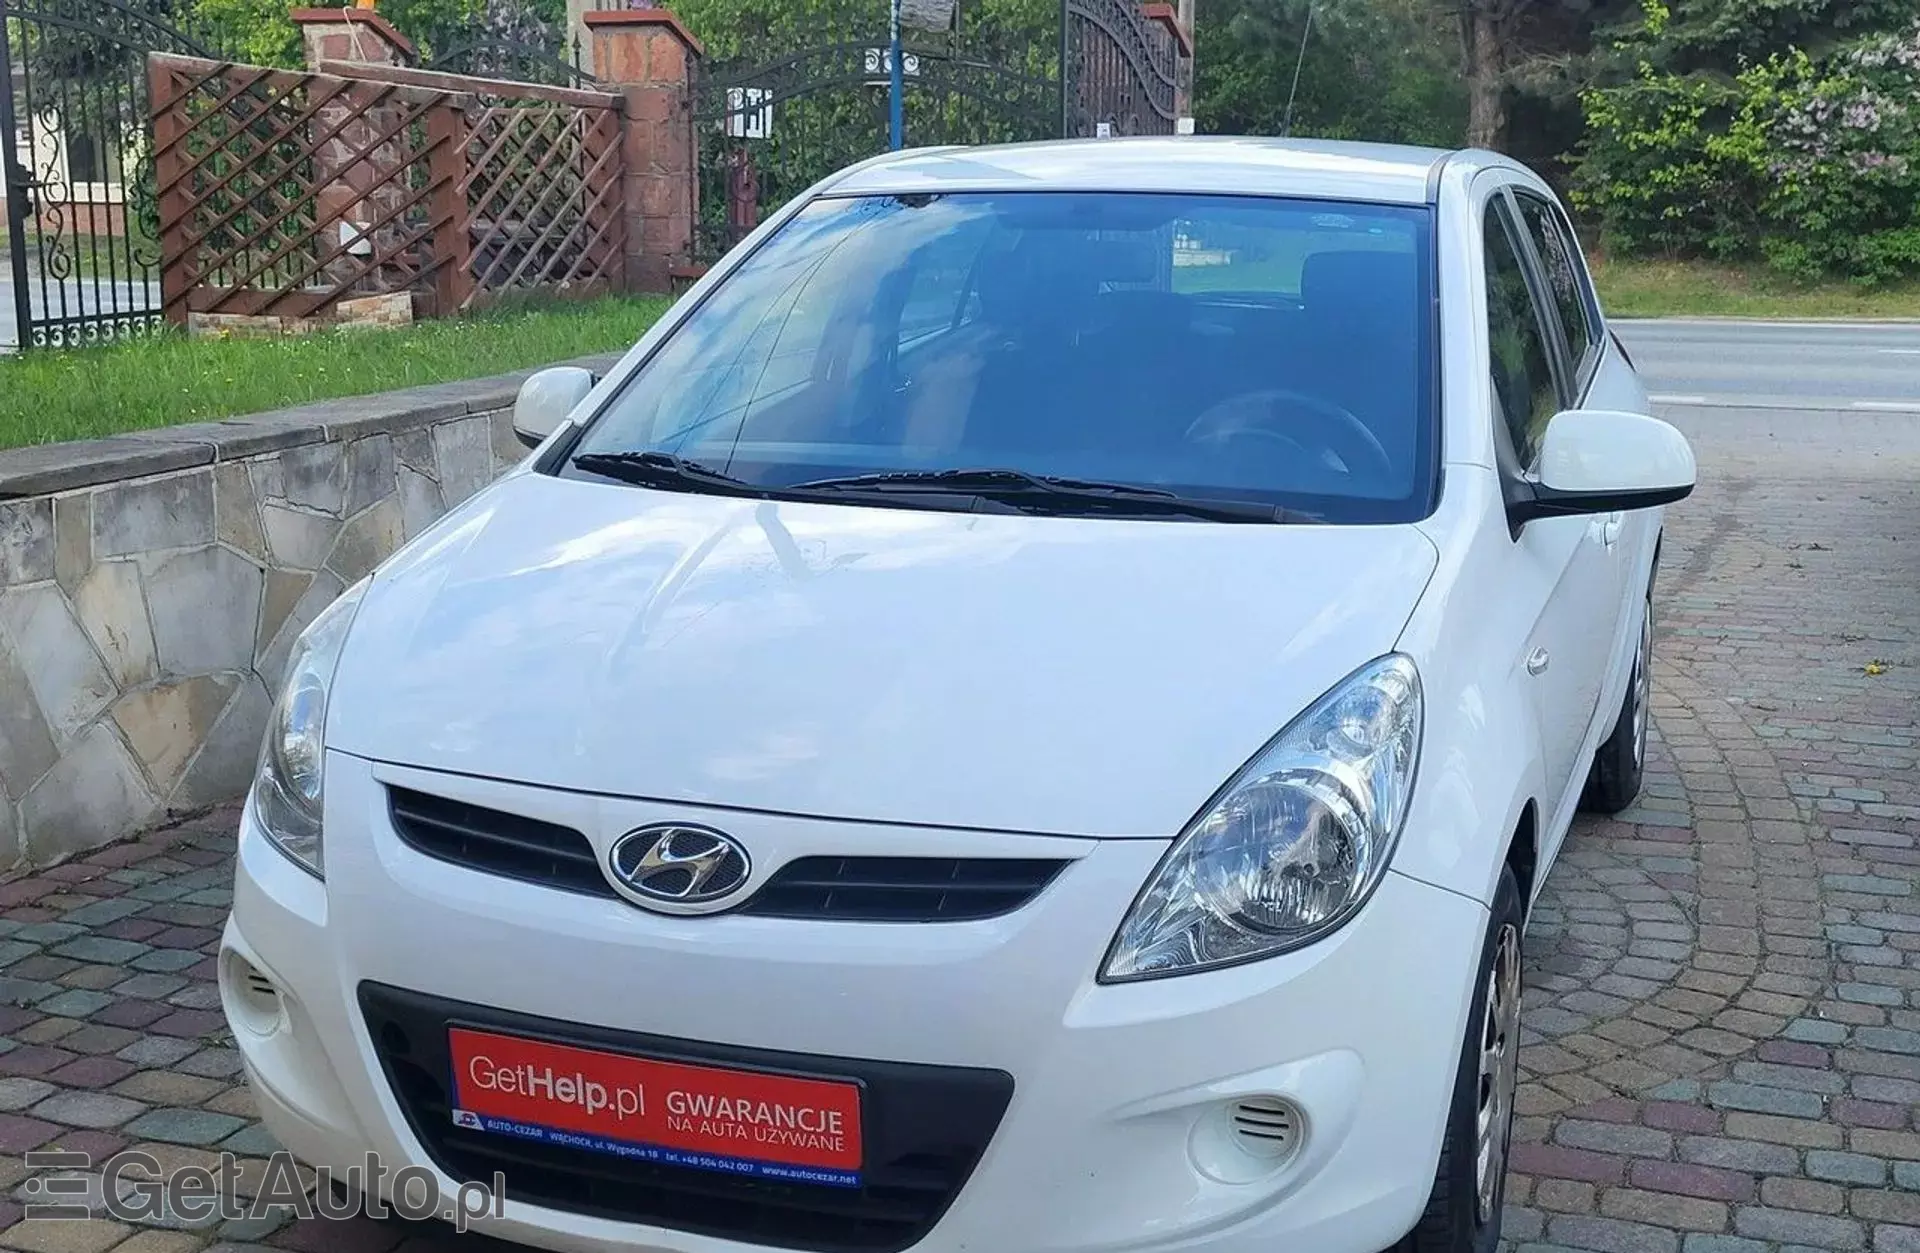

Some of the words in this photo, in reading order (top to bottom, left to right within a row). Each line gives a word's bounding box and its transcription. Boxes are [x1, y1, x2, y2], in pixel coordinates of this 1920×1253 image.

[469, 1055, 645, 1120] GetHelp.pl
[666, 1090, 843, 1135] GWARANCJE
[487, 1119, 543, 1138] AUTO-CEZAR
[665, 1152, 680, 1163] tel.
[682, 1155, 698, 1166] +48
[700, 1157, 717, 1169] 504
[718, 1159, 735, 1170] 042
[736, 1162, 754, 1173] 007
[762, 1166, 857, 1185] www.autocezar.net
[667, 1115, 693, 1133] NA
[700, 1120, 748, 1140] AUTA
[754, 1126, 845, 1152] UŻYWANE
